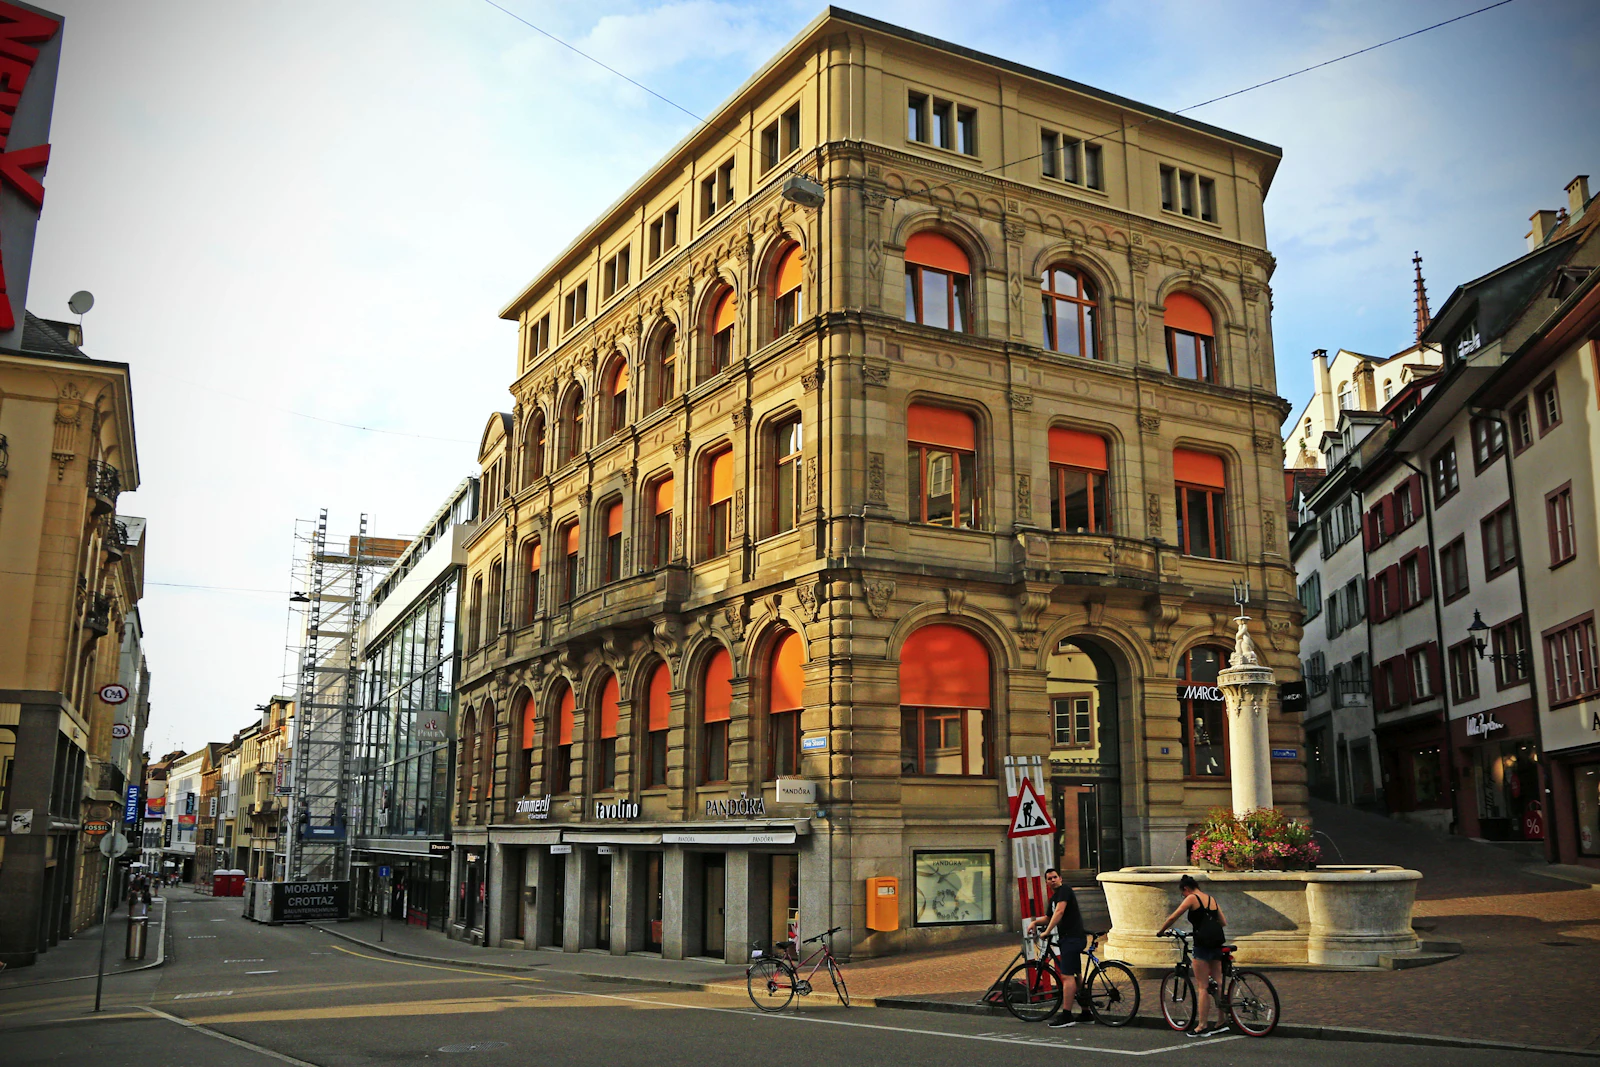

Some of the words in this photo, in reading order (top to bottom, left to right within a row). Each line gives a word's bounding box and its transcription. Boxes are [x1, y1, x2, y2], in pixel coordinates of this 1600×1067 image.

[103, 689, 123, 699] C&A
[782, 787, 811, 795] PANDORA
[515, 793, 551, 813] zimmerli
[705, 793, 766, 816] PANDORA
[595, 799, 639, 819] tavolino
[752, 835, 774, 843] PANDORA
[284, 883, 329, 894] MORATH
[287, 896, 334, 907] CROTTAZ
